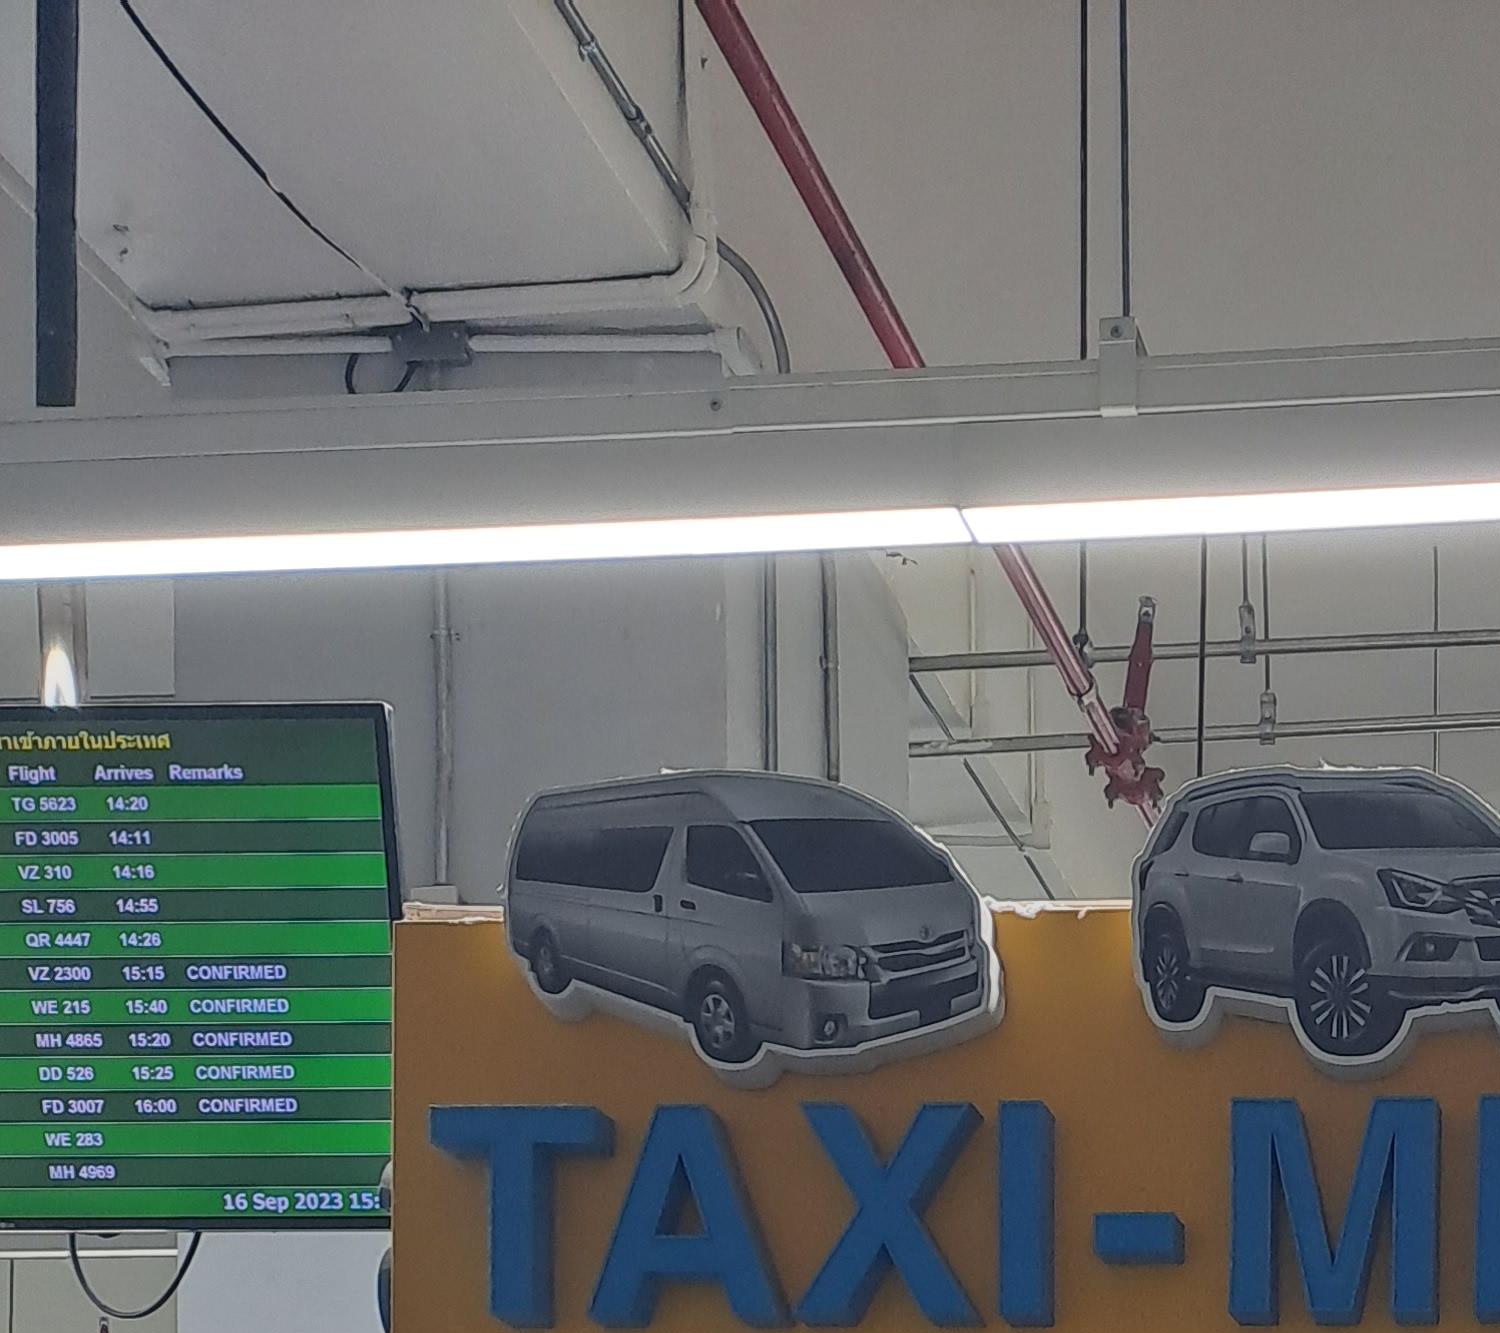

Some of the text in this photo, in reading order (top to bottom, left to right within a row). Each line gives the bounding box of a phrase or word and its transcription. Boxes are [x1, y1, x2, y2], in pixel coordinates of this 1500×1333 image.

[0, 731, 170, 750] าเข้าภายในประเทศ
[8, 764, 244, 785] Flight Arrives Remarks
[11, 796, 149, 812] TG 5623 14:20
[14, 831, 151, 846] FD 3005 14:11
[18, 865, 155, 880] VZ 310 14:16
[21, 899, 159, 913] SL 756 14:55
[25, 933, 51, 948] QR
[55, 933, 91, 947] 4447
[28, 965, 287, 981] VZ 2300 15:15 CONFIRMED
[31, 999, 289, 1015] WE 215 15:40 CONFIRMED
[35, 1032, 293, 1048] MH 4865 15:20 CONFIRMED
[38, 1065, 295, 1081] DD 526 15:25 CONFIRMED
[41, 1098, 298, 1114] FD 3007 16:00 CONFIRMED
[45, 1133, 104, 1147] WE 283
[49, 1165, 76, 1180] MH
[223, 1193, 382, 1214] 16 Sep 2023 15:
